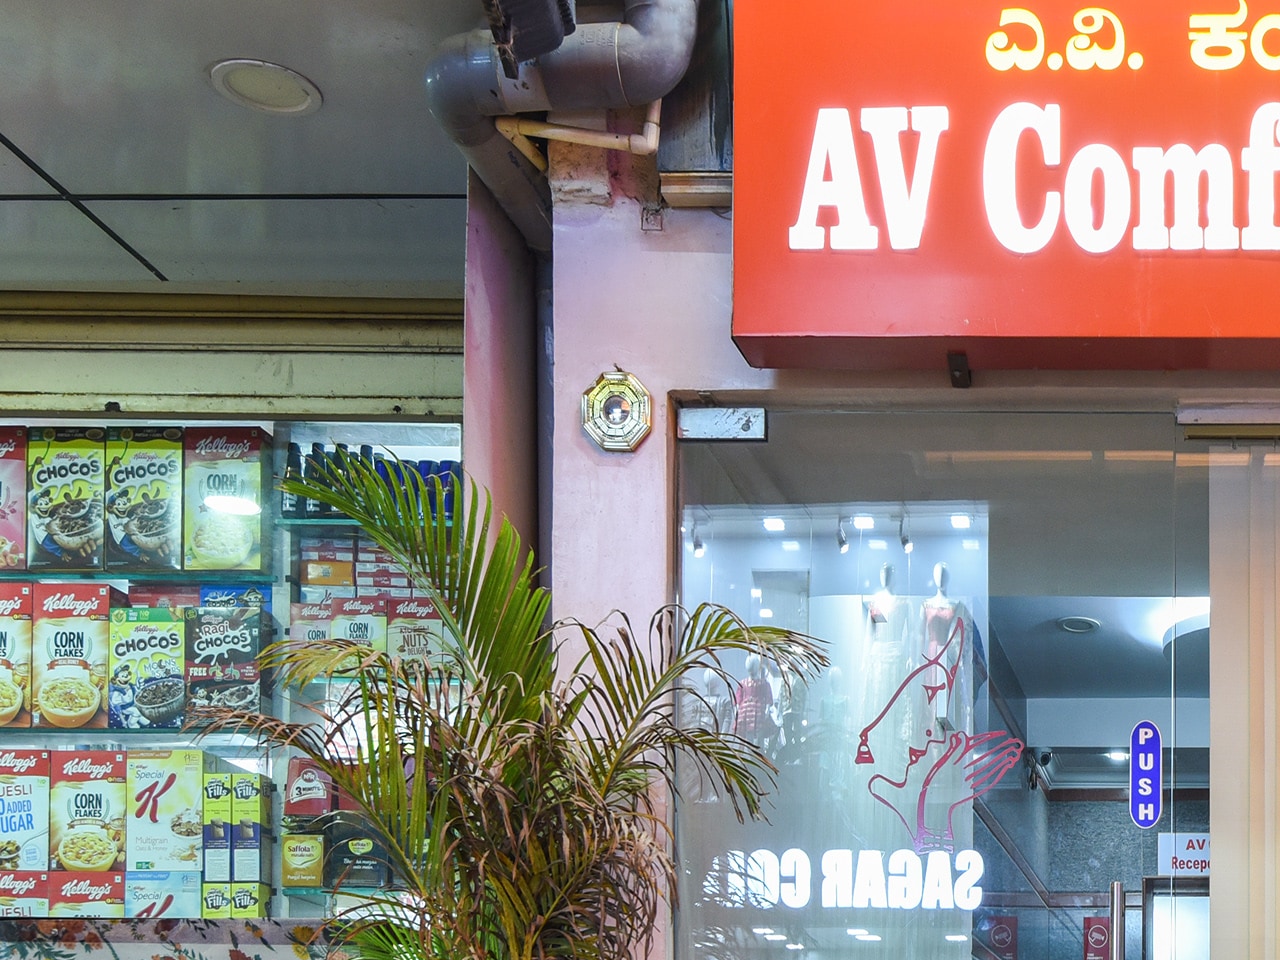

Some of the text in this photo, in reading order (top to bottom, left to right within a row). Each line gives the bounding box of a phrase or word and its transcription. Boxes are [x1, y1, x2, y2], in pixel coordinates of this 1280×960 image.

[788, 105, 950, 251] AV
[195, 436, 251, 458] Kellogg's
[36, 459, 100, 484] CHOCOS
[114, 459, 178, 484] CHOCOS
[206, 474, 238, 491] CORN
[43, 593, 100, 616] Kellogg's
[342, 600, 374, 614] Kellogg's
[396, 600, 434, 617] Kellogg's
[203, 621, 229, 636] Ragi
[348, 622, 369, 633] CORN
[54, 632, 84, 648] CORN
[196, 632, 248, 651] CHOCOS
[348, 632, 369, 640] FLAKES
[403, 633, 429, 648] NUTS
[115, 632, 180, 657] CHOCOS
[54, 648, 84, 658] FLAKES
[189, 666, 207, 677] FREE
[62, 757, 114, 779] Kellogg's
[135, 770, 165, 780] Special
[1137, 727, 1155, 821] PUSH
[134, 772, 177, 824] K
[207, 785, 228, 799] Fills
[235, 785, 258, 799] Fills
[7, 799, 32, 814] ADDED
[75, 793, 102, 809] CORN
[75, 809, 102, 818] FLAKES
[135, 836, 169, 846] Multigrain
[1185, 839, 1207, 851] AV
[288, 845, 311, 853] Saffola
[61, 879, 112, 900] Kellogg's
[132, 891, 162, 901] Special
[207, 895, 228, 909] Fills
[235, 895, 257, 909] Fills
